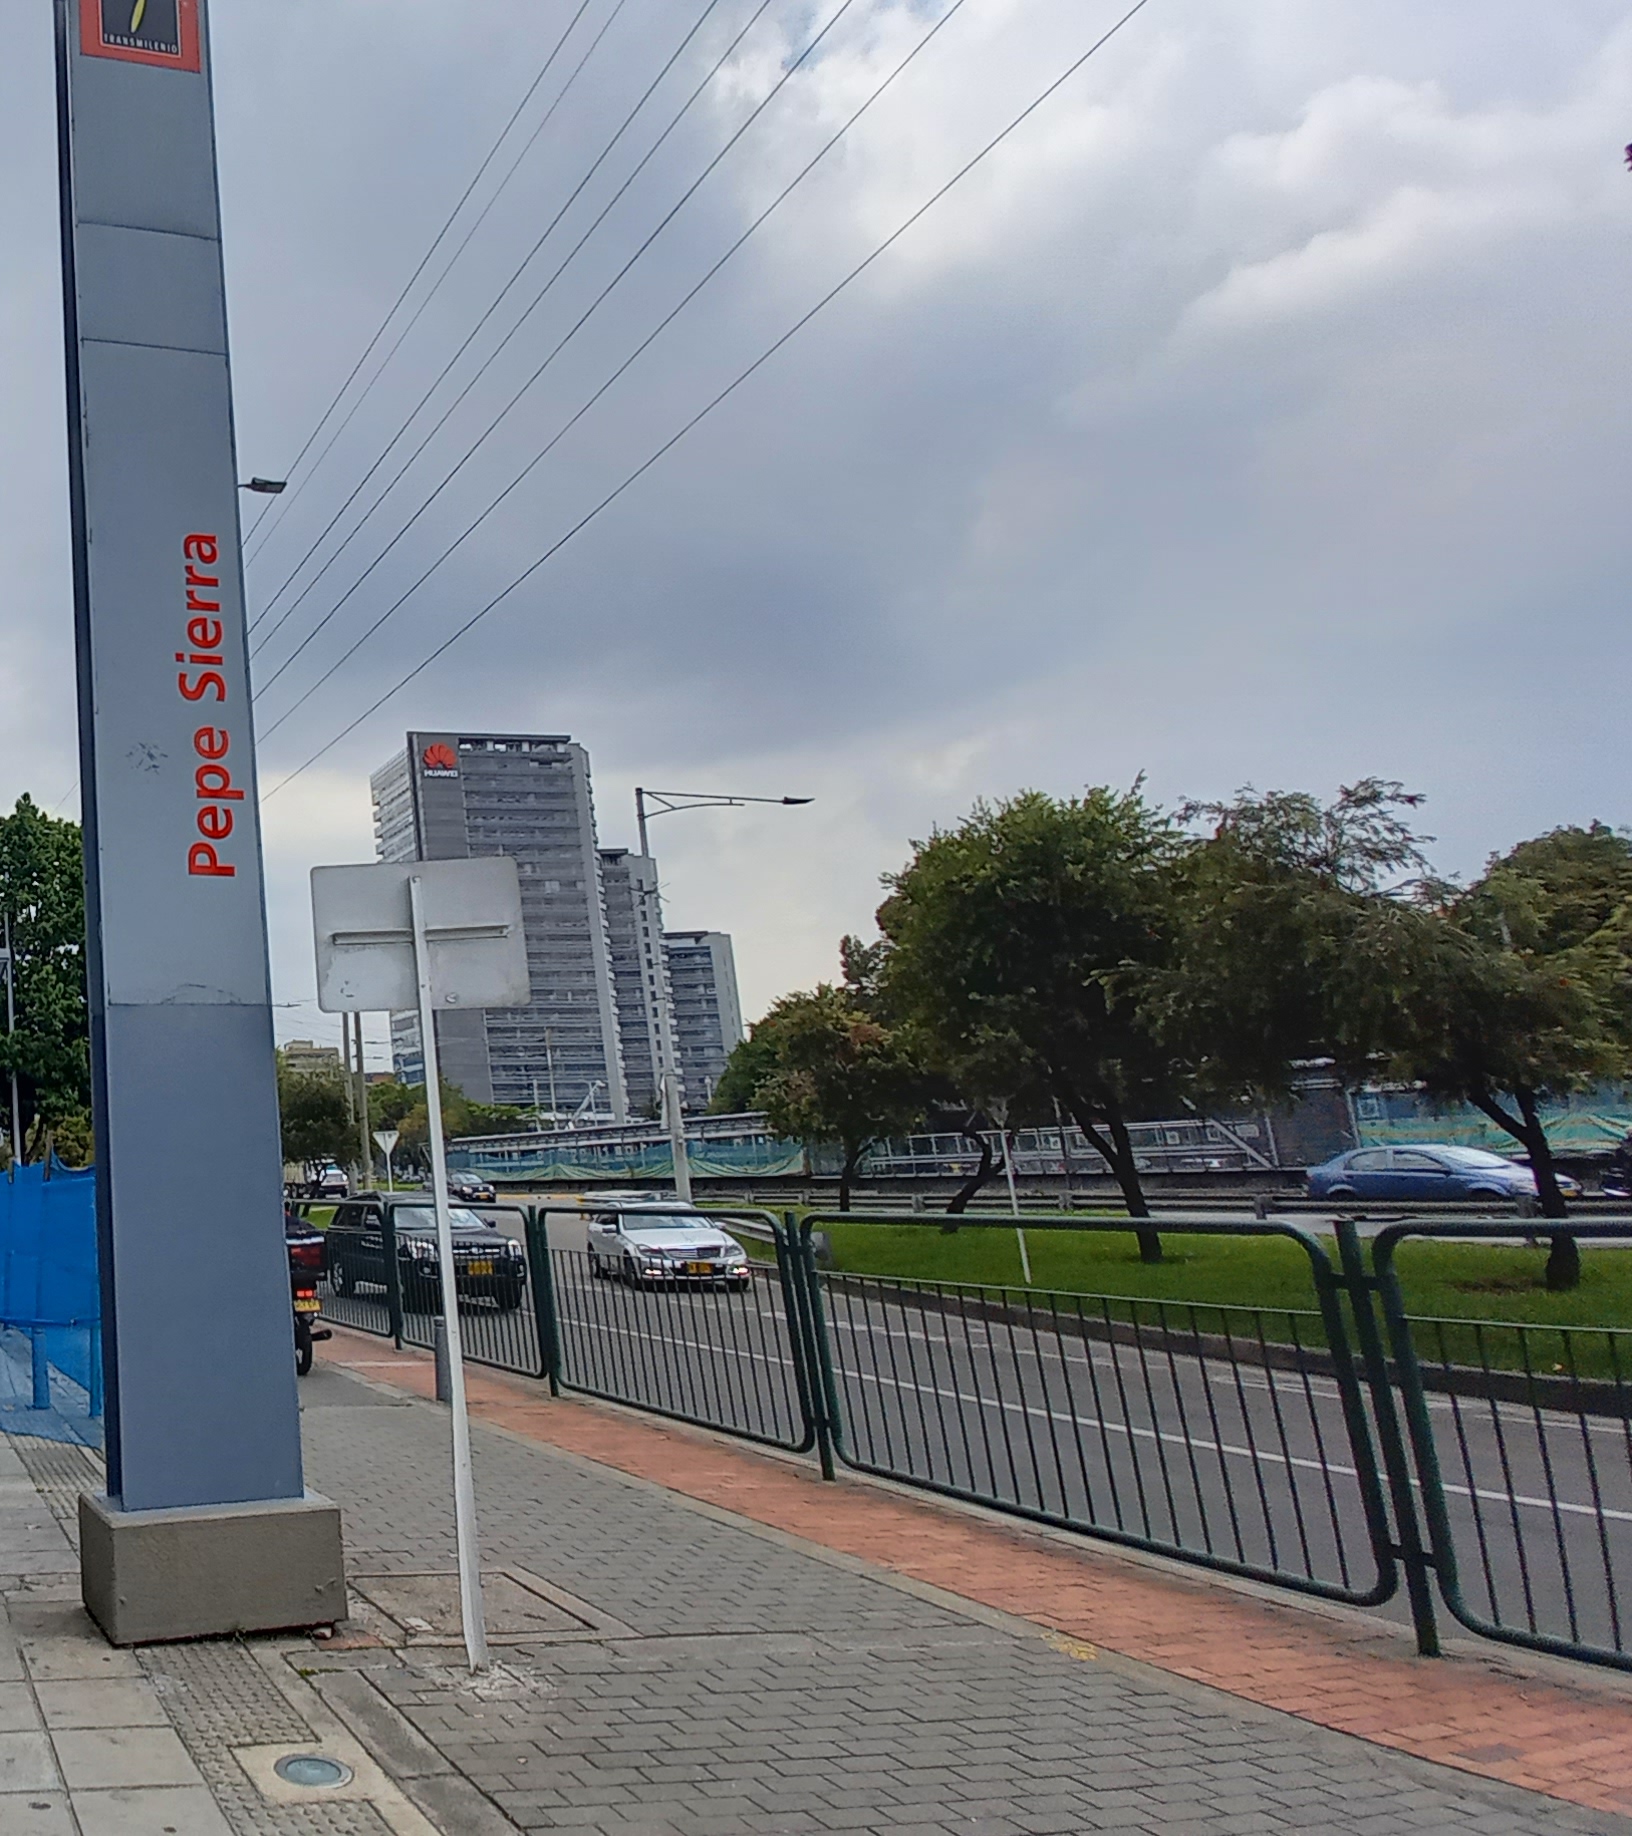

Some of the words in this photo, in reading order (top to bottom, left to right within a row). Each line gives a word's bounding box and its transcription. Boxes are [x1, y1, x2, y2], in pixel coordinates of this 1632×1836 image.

[104, 32, 178, 54] TRANSMILENIO
[175, 532, 226, 702] Sierra
[187, 725, 245, 877] Pepe
